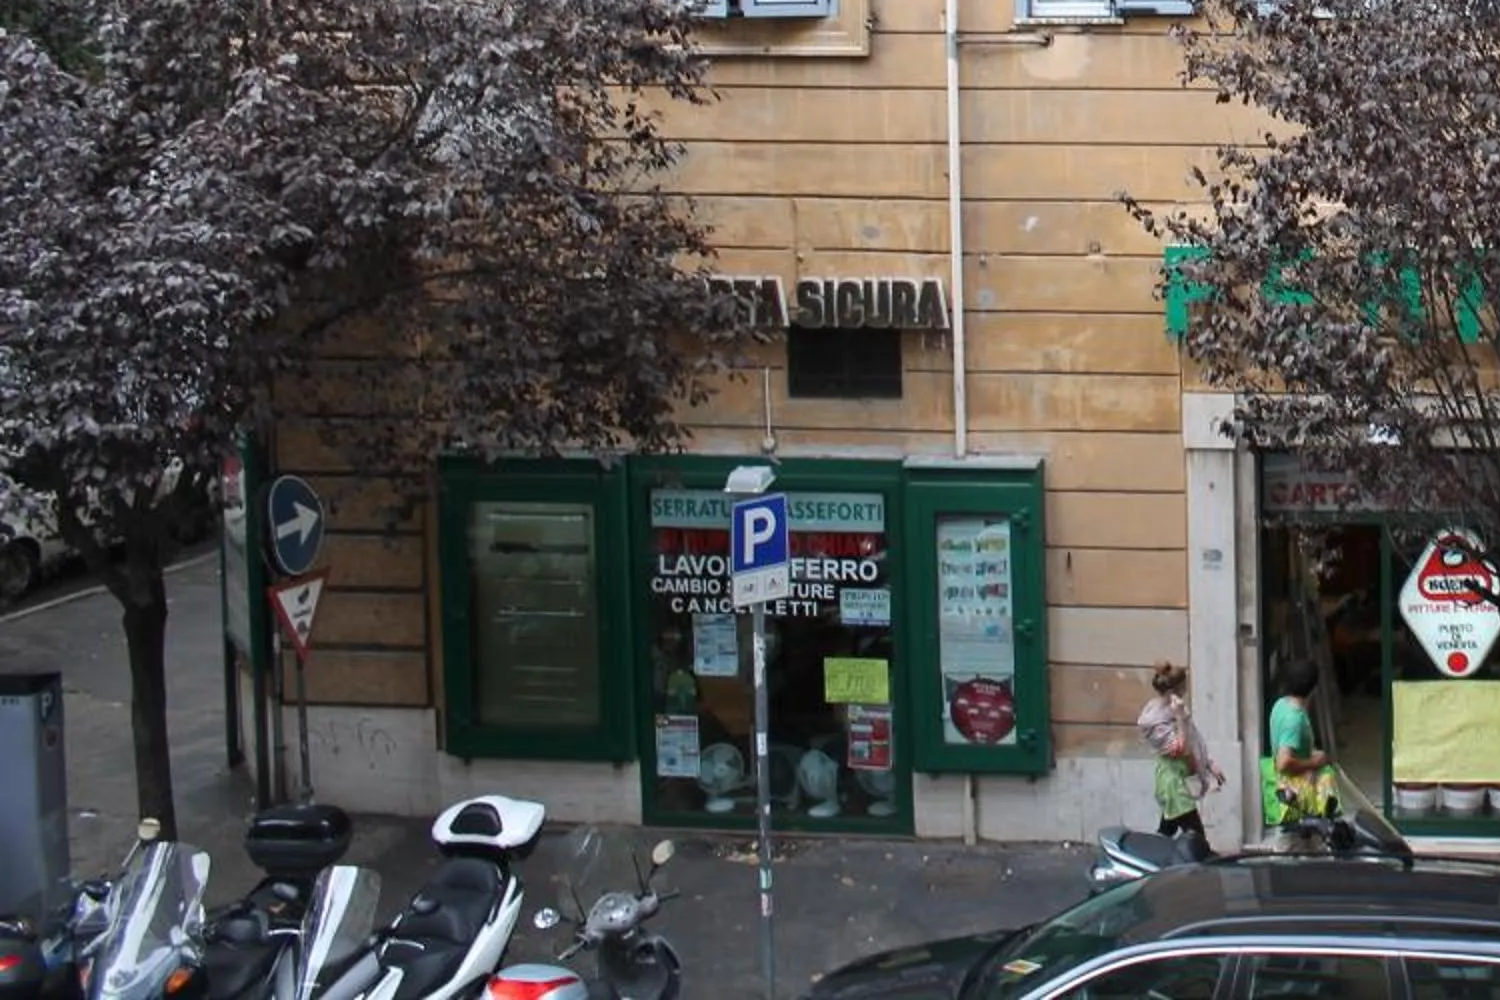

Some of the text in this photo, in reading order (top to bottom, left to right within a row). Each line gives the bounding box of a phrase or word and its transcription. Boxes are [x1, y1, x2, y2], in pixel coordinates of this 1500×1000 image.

[797, 277, 949, 328] SICURA
[786, 503, 882, 522] ASSEFORTI
[743, 507, 777, 565] P
[791, 559, 878, 581] FERRO
[652, 577, 721, 595] CAMBIO
